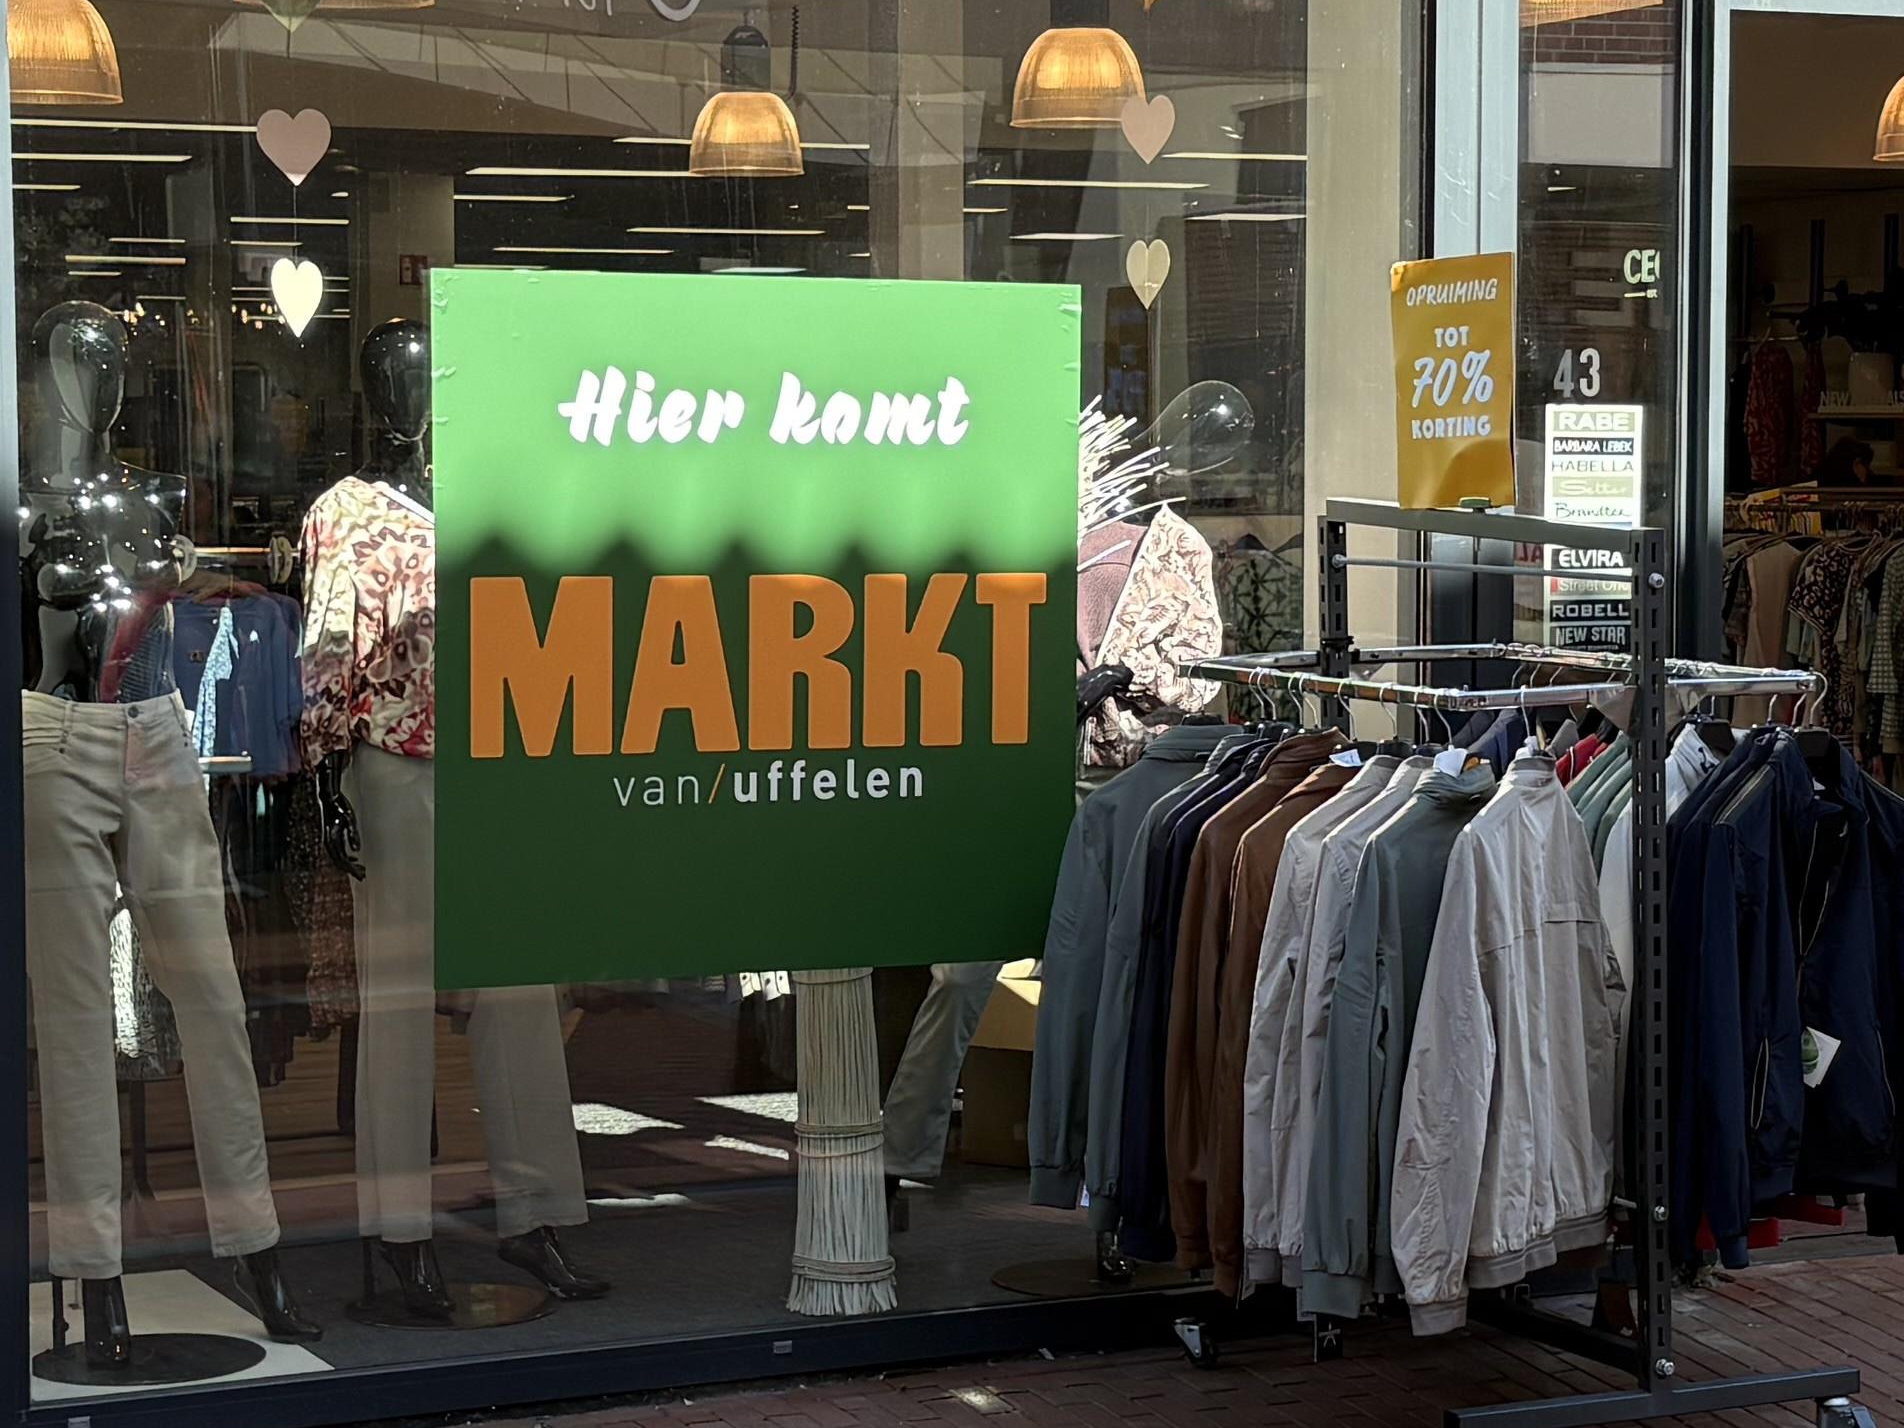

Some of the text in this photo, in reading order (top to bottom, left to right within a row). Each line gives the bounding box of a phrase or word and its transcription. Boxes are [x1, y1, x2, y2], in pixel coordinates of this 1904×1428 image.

[1406, 278, 1498, 307] OPRUIMING
[1434, 325, 1470, 348] TOT
[1411, 349, 1494, 409] 70%
[1553, 347, 1601, 399] 43
[558, 365, 971, 447] Hier komt
[1411, 414, 1491, 440] KORTING
[1559, 412, 1629, 431] RABE
[1554, 439, 1601, 453] BARBARA
[1558, 549, 1624, 567] ELVIRA
[1552, 603, 1629, 617] ROBELL
[1556, 626, 1626, 646] NEW STAR
[470, 573, 1047, 758] MARKT
[613, 759, 924, 807] van/uffelen
